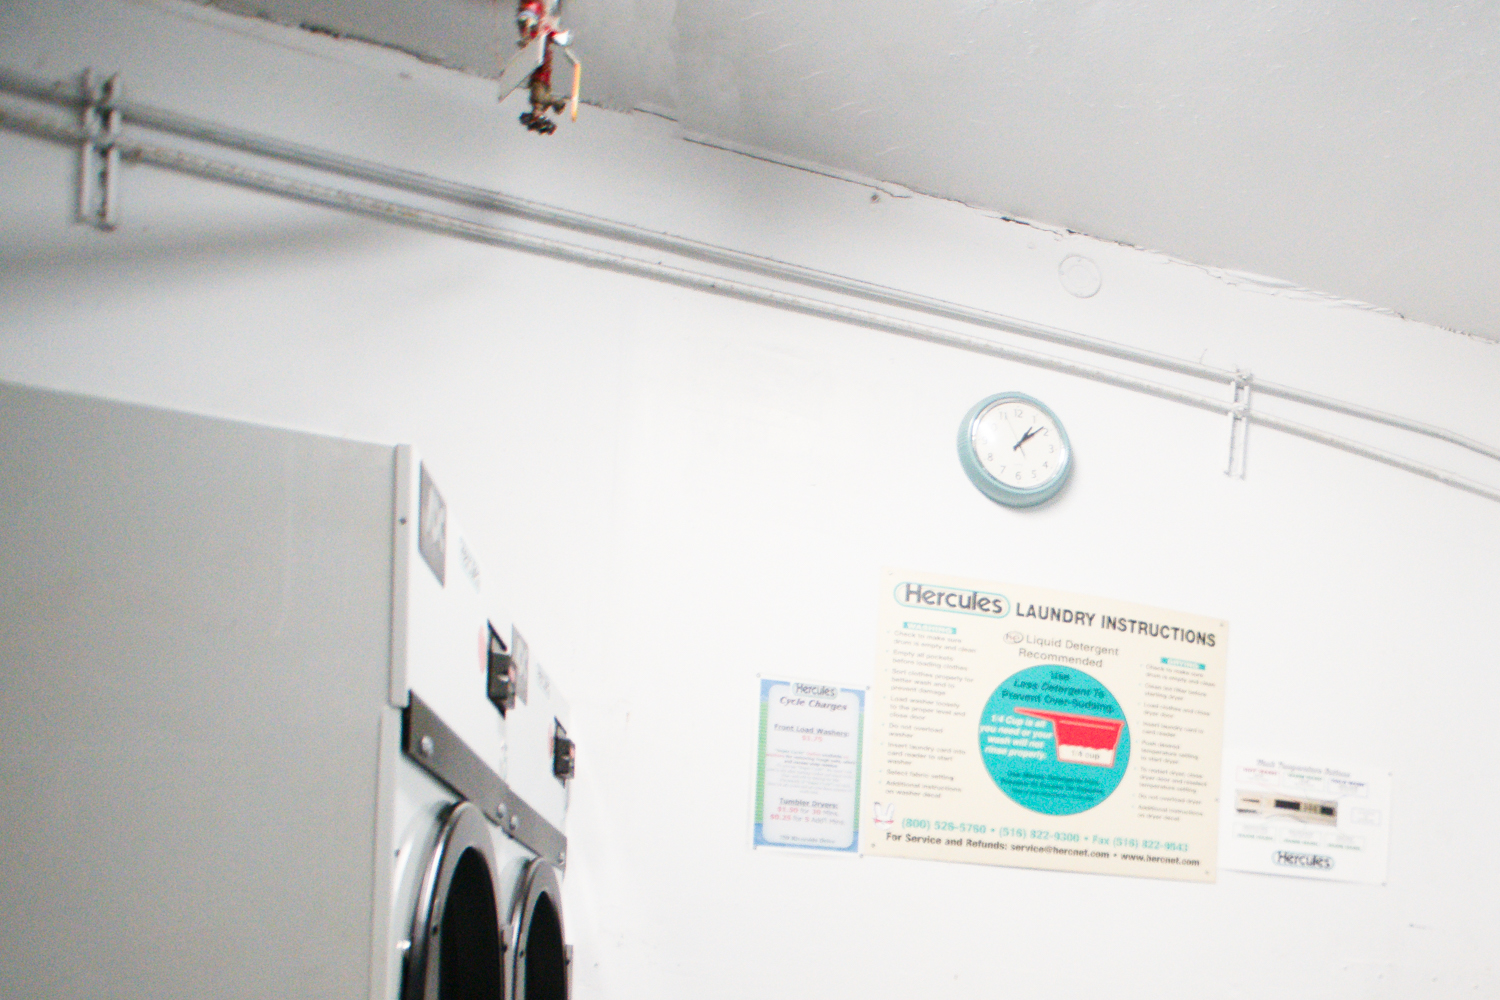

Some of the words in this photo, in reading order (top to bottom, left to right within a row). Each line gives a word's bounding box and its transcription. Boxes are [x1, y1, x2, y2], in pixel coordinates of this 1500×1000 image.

[1014, 409, 1023, 418] 12
[1043, 427, 1049, 436] 2
[1049, 445, 1054, 453] 3
[987, 453, 994, 461] 8
[1000, 466, 1006, 474] 7
[1042, 461, 1048, 469] 4
[1015, 471, 1022, 480] 6
[1031, 470, 1037, 479] 5
[905, 583, 1003, 614] Hercules
[1016, 602, 1096, 627] LAUNDRY
[1101, 615, 1216, 648] INSTRUCTIONS
[1026, 633, 1061, 650] Liquid
[1065, 639, 1119, 658] Detergent
[1018, 647, 1102, 668] Recommended
[1050, 670, 1069, 681] Use
[795, 682, 836, 698] Hercules
[1014, 678, 1038, 690] Less
[1042, 682, 1090, 698] Detergent
[1093, 688, 1104, 698] To
[1001, 689, 1040, 703] Prevent
[779, 696, 805, 707] Cycle
[809, 699, 847, 711] Charges
[991, 714, 1003, 723] 1/4
[1005, 715, 1022, 726] Cup
[1024, 718, 1032, 726] is
[1034, 719, 1047, 728] all
[774, 724, 794, 732] Front
[797, 726, 813, 735] Load
[817, 728, 849, 737] Washers:
[980, 724, 996, 733] you
[998, 726, 1023, 736] need
[1032, 730, 1053, 741] your
[987, 734, 1010, 745] wash
[1012, 737, 1027, 747] will
[1029, 739, 1044, 749] not
[984, 745, 1007, 755] rinse
[1007, 747, 1047, 761] properly.
[779, 798, 809, 807] Tumbler
[812, 801, 838, 809] Dryers:
[901, 817, 931, 831] (800)
[999, 826, 1026, 840] (516)
[1029, 829, 1079, 843] 822-9300
[1092, 834, 1109, 845] Fax
[1112, 837, 1138, 850] (516)
[886, 831, 901, 841] For
[905, 833, 941, 845] Service
[944, 837, 962, 846] and
[966, 838, 1007, 850] Refunds:
[1011, 842, 1109, 859] service@hercnet.com
[1120, 852, 1200, 866] www.hercnet.com
[1278, 851, 1330, 869] Hercules
